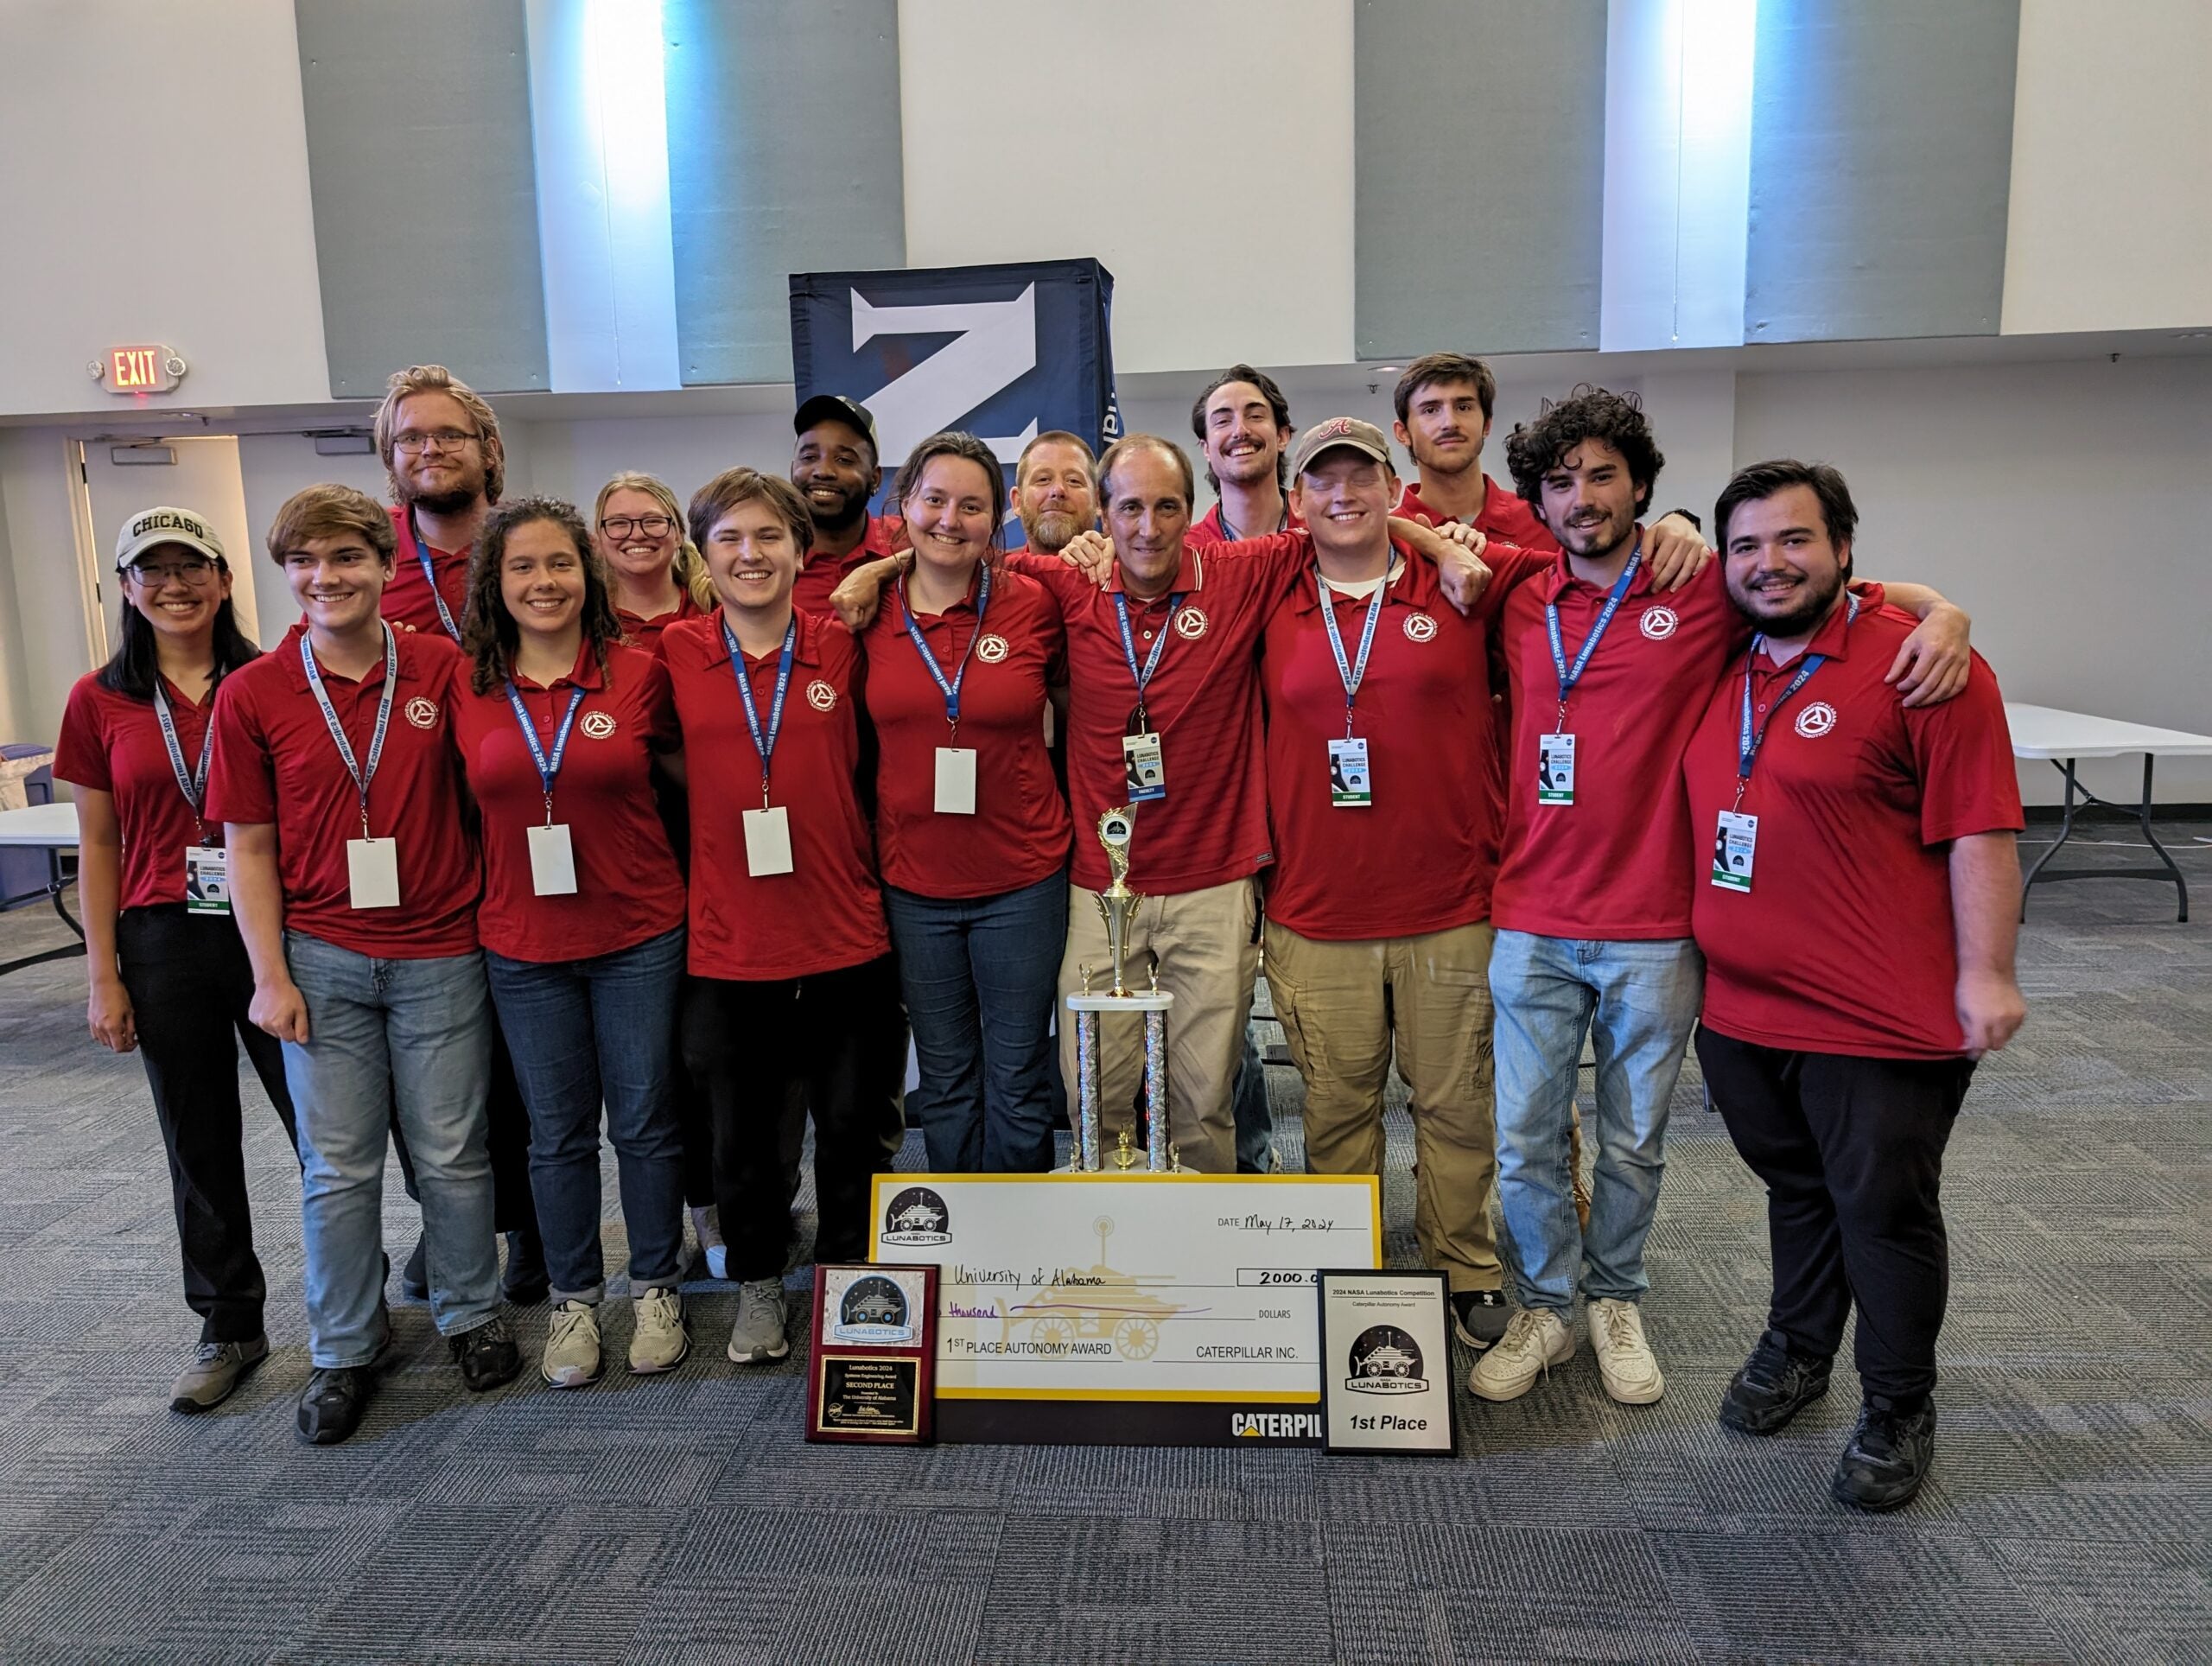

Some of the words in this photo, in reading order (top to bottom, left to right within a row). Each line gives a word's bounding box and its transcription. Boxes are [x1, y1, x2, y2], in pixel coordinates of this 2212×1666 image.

[114, 350, 156, 386] EXIT
[1319, 419, 1351, 440] A
[132, 515, 204, 539] CHICAGO
[1117, 602, 1127, 620] 2024
[1122, 620, 1135, 664] Lunabotics
[1548, 617, 1560, 658] Lunabotics
[1557, 658, 1567, 679] 2024
[1569, 660, 1583, 681] NASA
[1581, 616, 1607, 662] Lunabotics
[1602, 597, 1618, 617] 2024
[919, 644, 944, 682] Lunabotics
[778, 672, 787, 693] 2024
[1789, 670, 1810, 691] 2024
[738, 672, 747, 694] NASA
[743, 692, 759, 735] Lunabotics
[770, 690, 784, 735] Lunabotics
[512, 696, 524, 715] NASA
[519, 713, 539, 752] Lunabotics
[535, 752, 548, 772] 2024
[766, 734, 775, 755] NASA
[550, 752, 560, 772] NASA
[1217, 1218, 1240, 1227] DATE
[1245, 1214, 1272, 1236] May
[955, 1264, 1020, 1291] University
[1032, 1267, 1044, 1286] of
[1052, 1268, 1106, 1287] Alabama
[1258, 1309, 1291, 1319] DOLLARS
[839, 1327, 906, 1337] LUNABOTICS
[947, 1338, 965, 1353] 1ST
[966, 1341, 1002, 1354] PLACE
[1004, 1342, 1069, 1355] AUTONOMY
[1071, 1343, 1111, 1355] AWARD
[1196, 1345, 1273, 1358] CATERPILLAR
[1275, 1346, 1299, 1359] INC.
[1231, 1413, 1322, 1438] CATERPIL
[1350, 1415, 1376, 1430] 1st
[1380, 1415, 1427, 1430] Place
